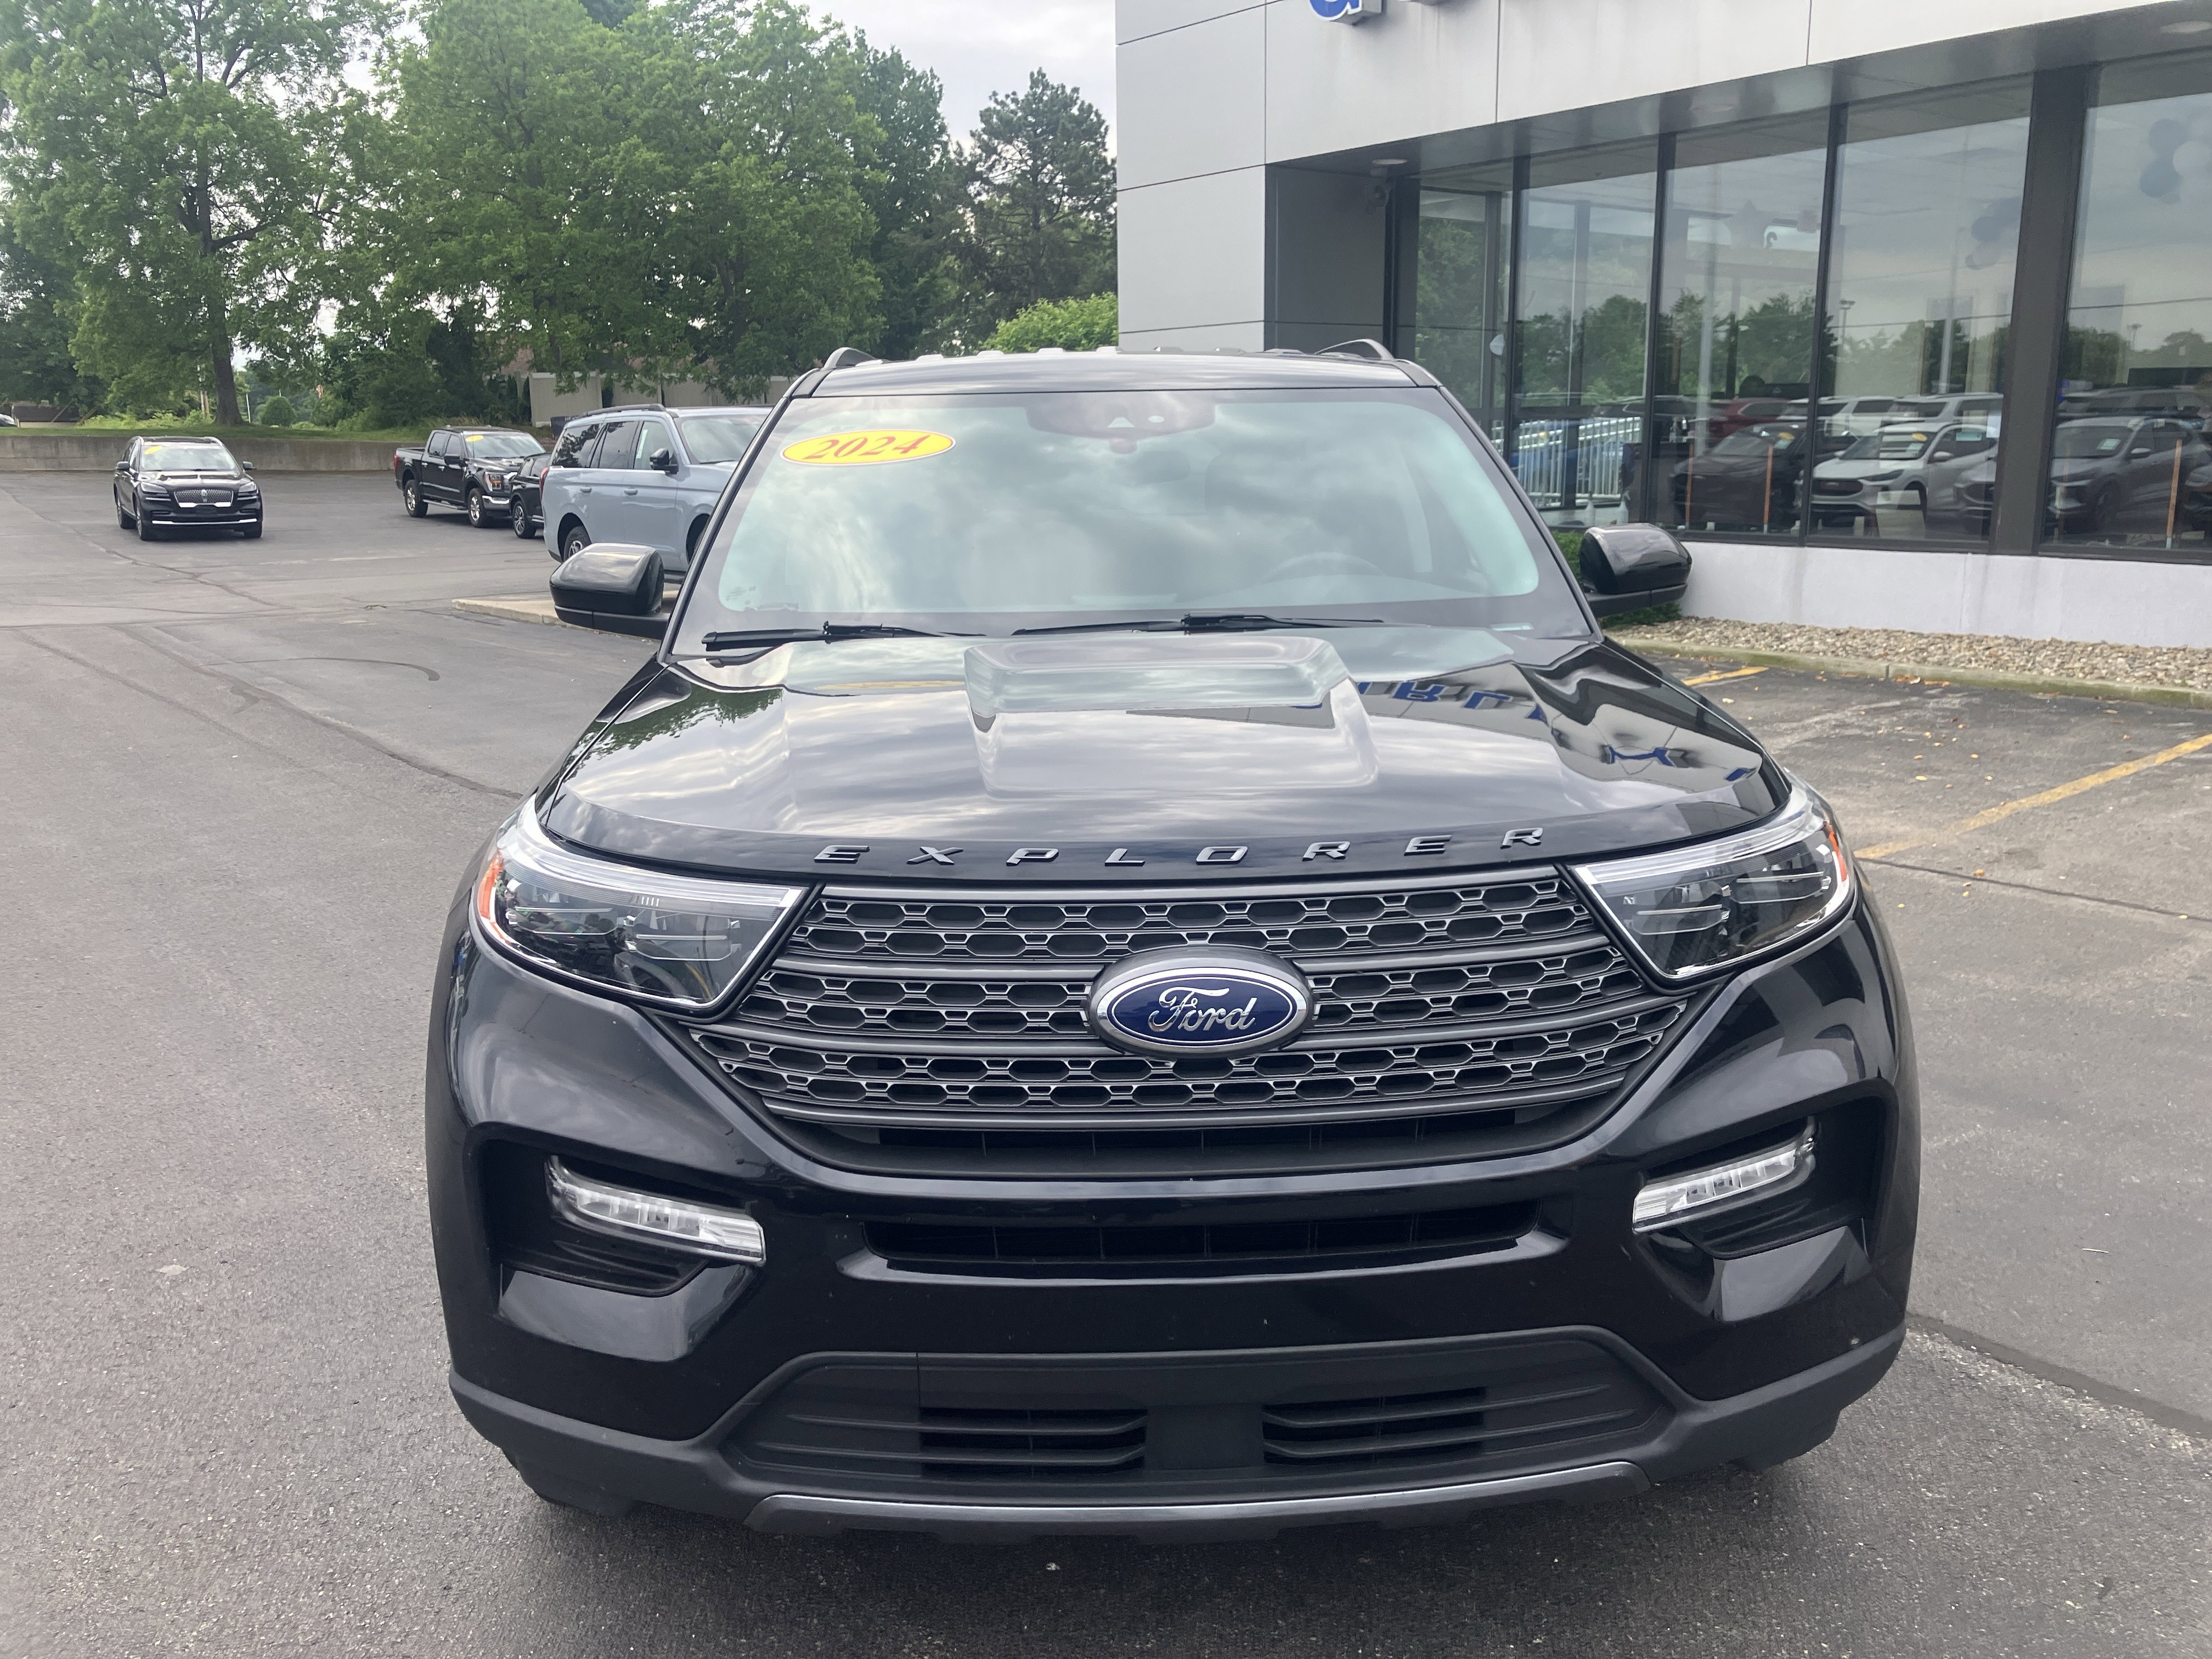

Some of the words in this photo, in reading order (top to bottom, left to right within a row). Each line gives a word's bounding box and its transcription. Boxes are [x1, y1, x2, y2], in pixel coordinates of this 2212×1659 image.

[803, 435, 930, 460] 2024
[814, 827, 1543, 867] EXPLORER
[1148, 986, 1257, 1031] Ford
